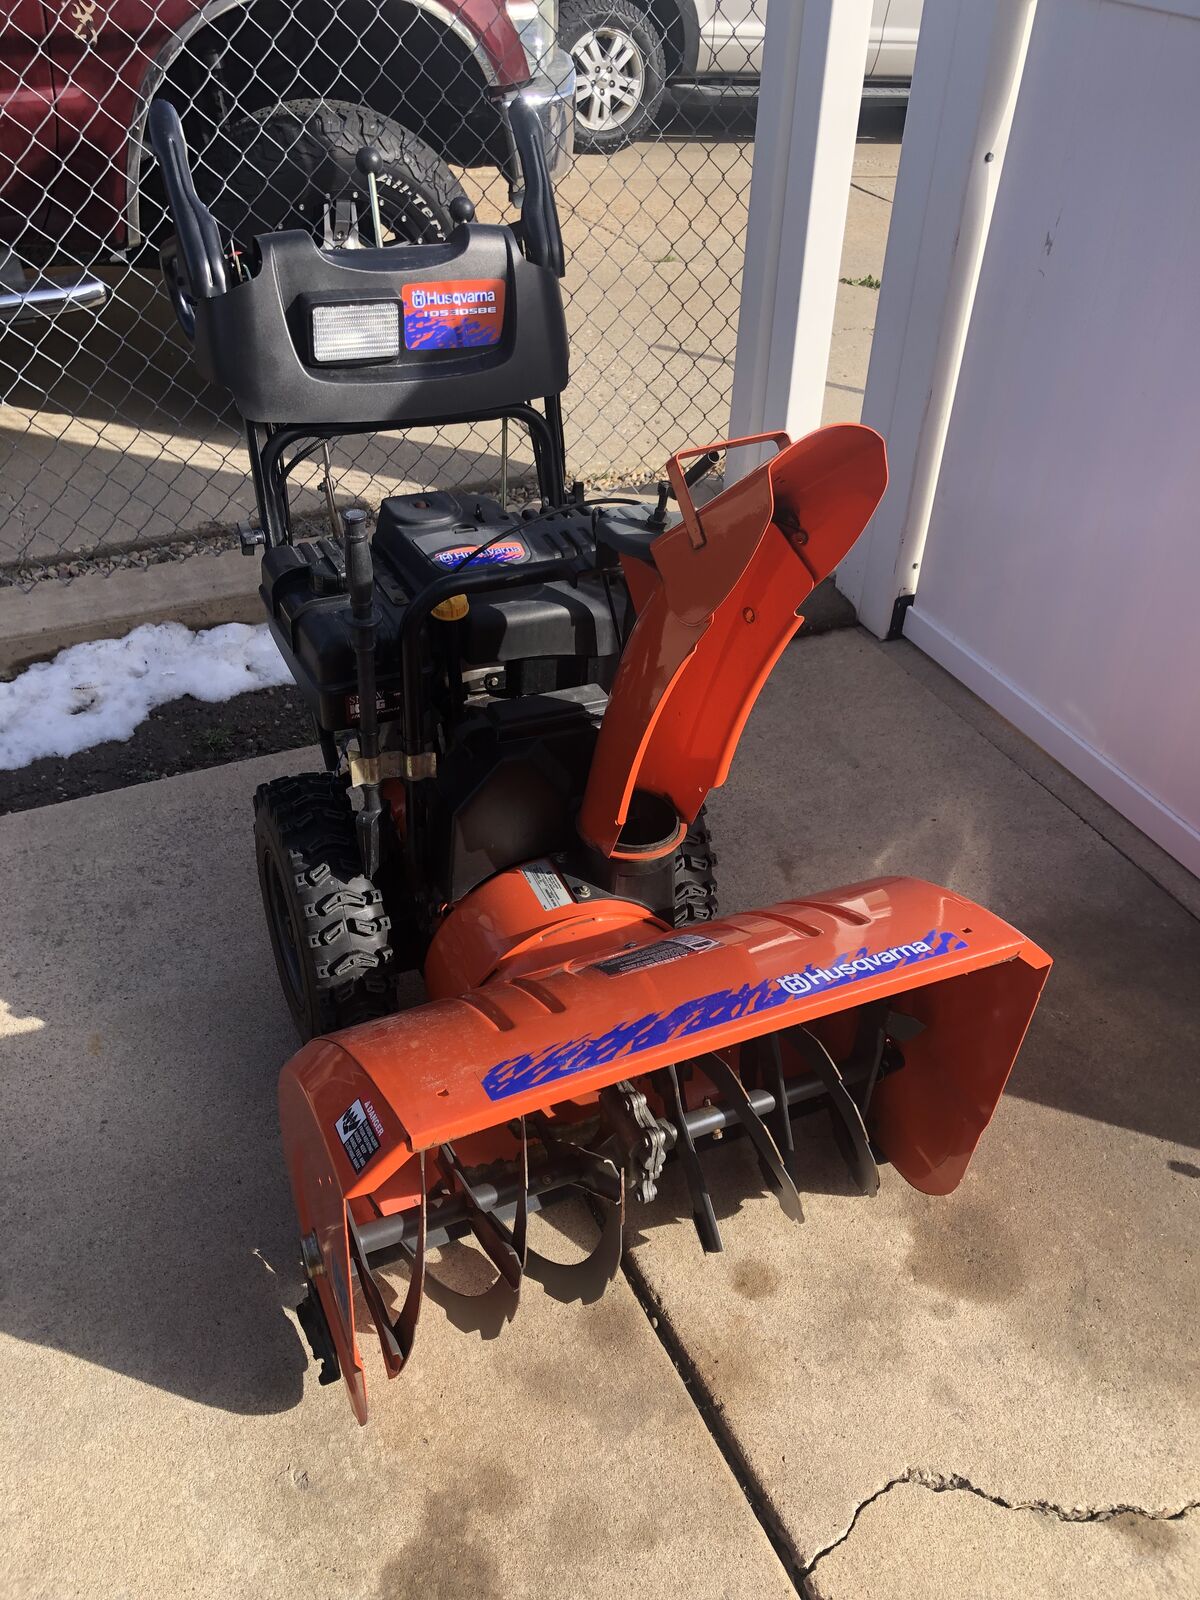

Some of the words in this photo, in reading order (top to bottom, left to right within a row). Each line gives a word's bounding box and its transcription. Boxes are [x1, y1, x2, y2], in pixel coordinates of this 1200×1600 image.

[427, 291, 496, 306] Husqvarna
[805, 941, 932, 985] Husqvarna
[366, 1106, 385, 1137] DANGER
